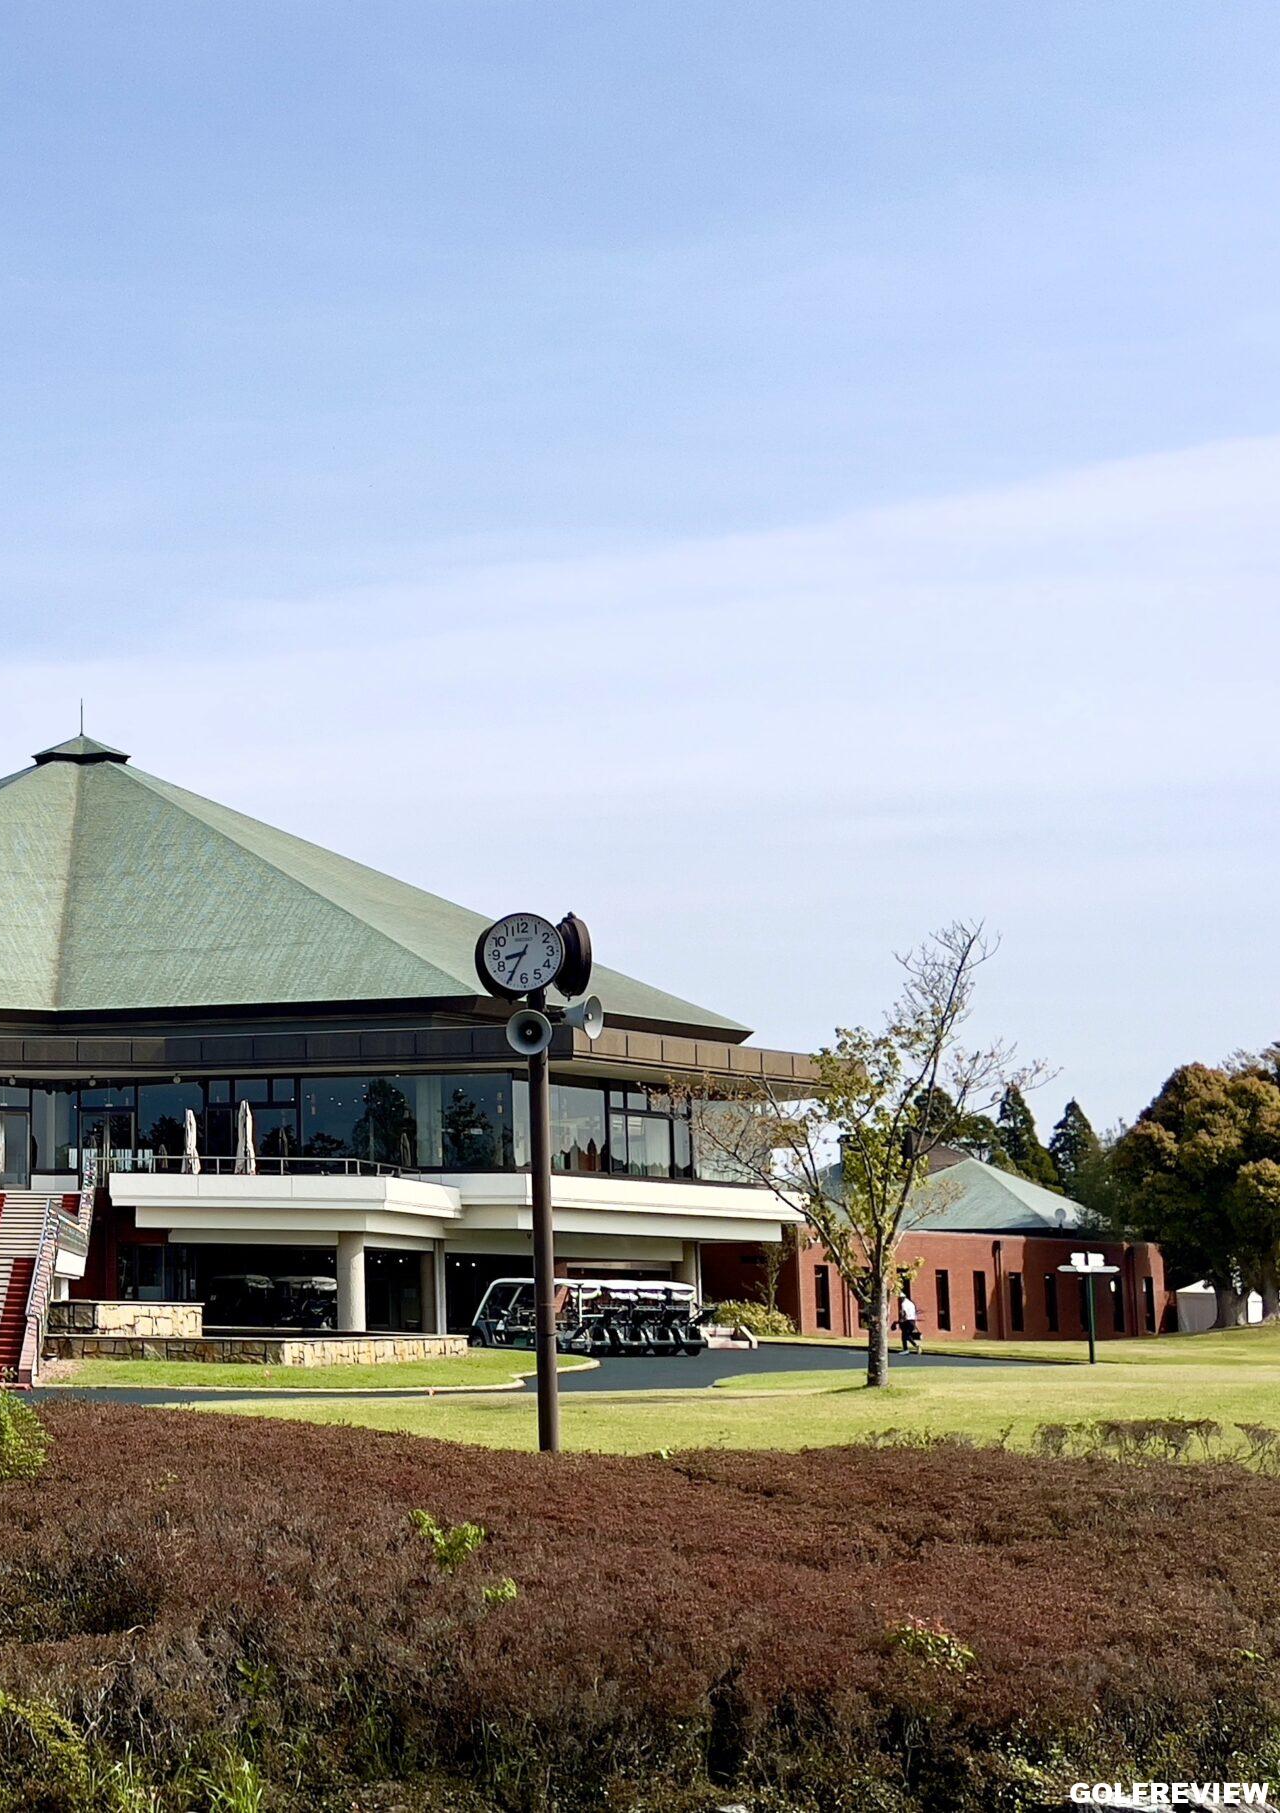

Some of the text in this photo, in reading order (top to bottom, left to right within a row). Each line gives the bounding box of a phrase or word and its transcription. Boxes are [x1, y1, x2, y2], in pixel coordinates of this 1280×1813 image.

[504, 923, 515, 937] 11
[517, 922, 529, 934] 12
[492, 936, 506, 947] 10
[542, 932, 550, 944] 2
[492, 949, 501, 961] 9
[546, 945, 555, 956] 3
[498, 961, 506, 972] 8
[542, 959, 551, 968] 4
[520, 973, 529, 984] 6
[533, 969, 542, 980] 5
